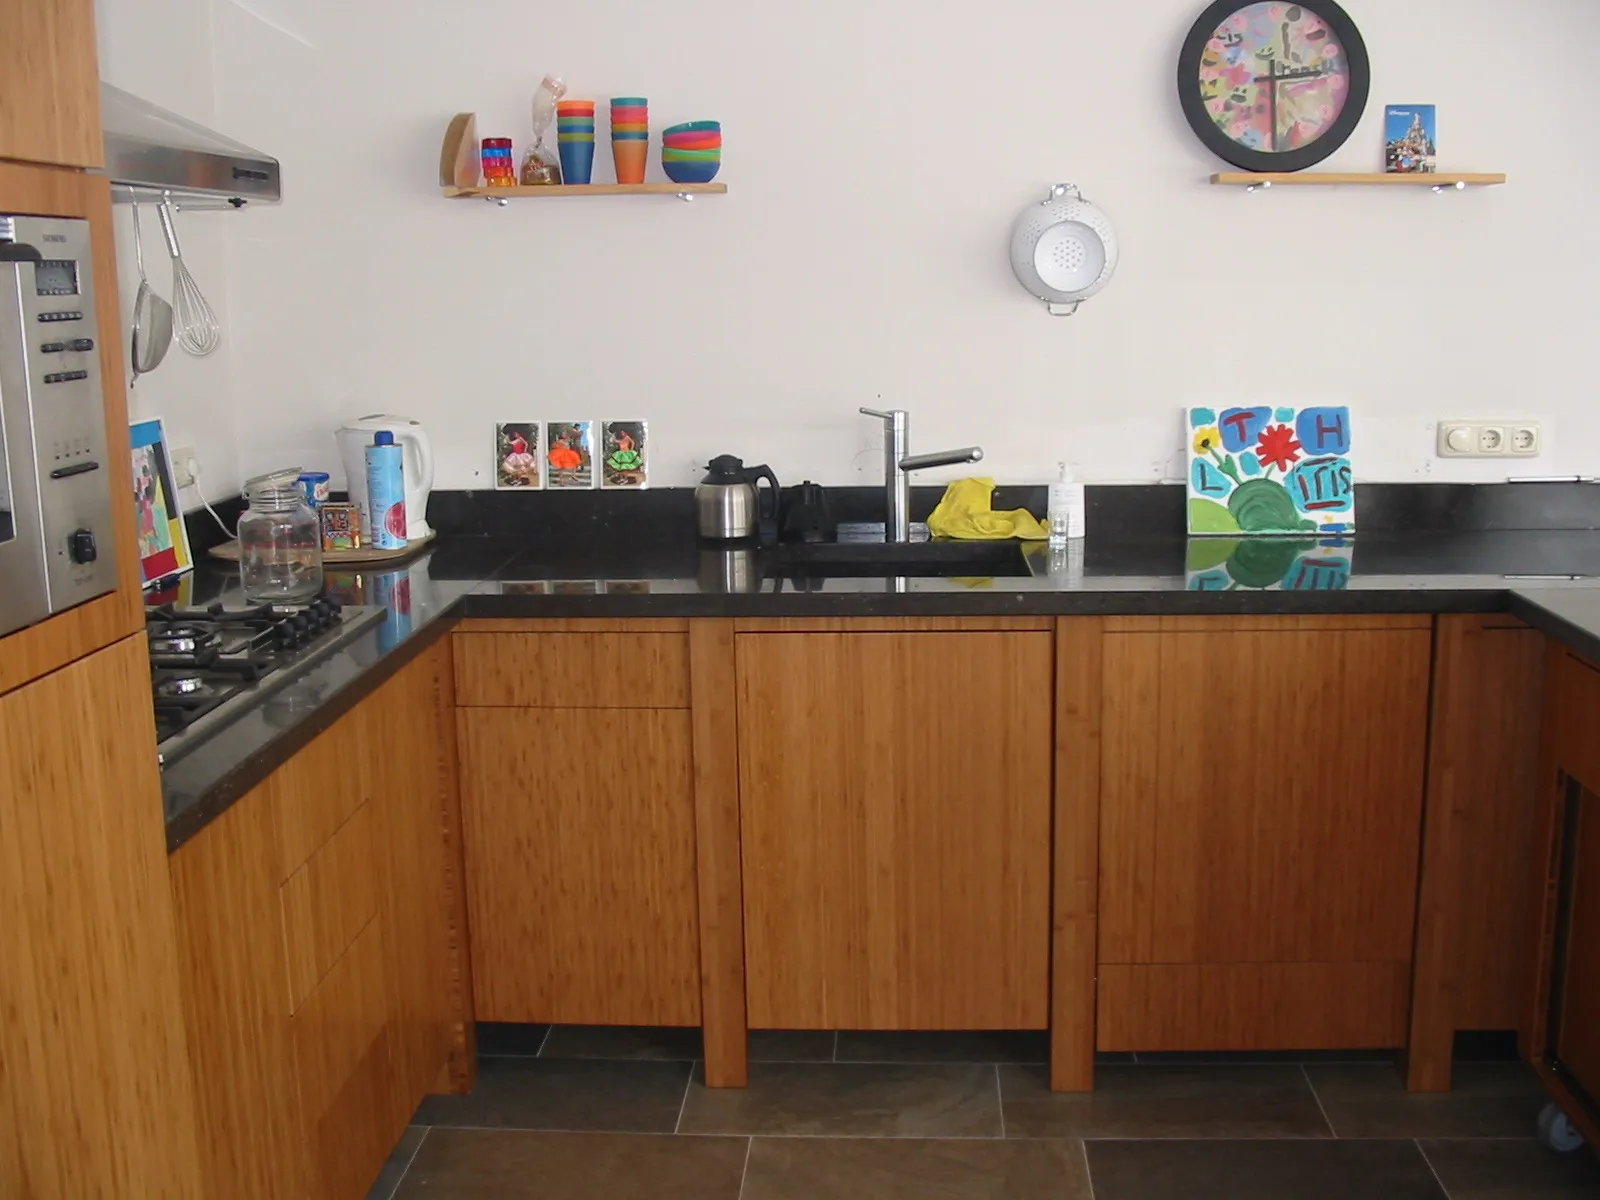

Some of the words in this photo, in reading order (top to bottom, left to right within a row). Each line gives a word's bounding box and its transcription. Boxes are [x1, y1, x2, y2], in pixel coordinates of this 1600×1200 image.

[1224, 412, 1255, 443] T
[1316, 414, 1343, 448] H
[1200, 464, 1224, 491] L
